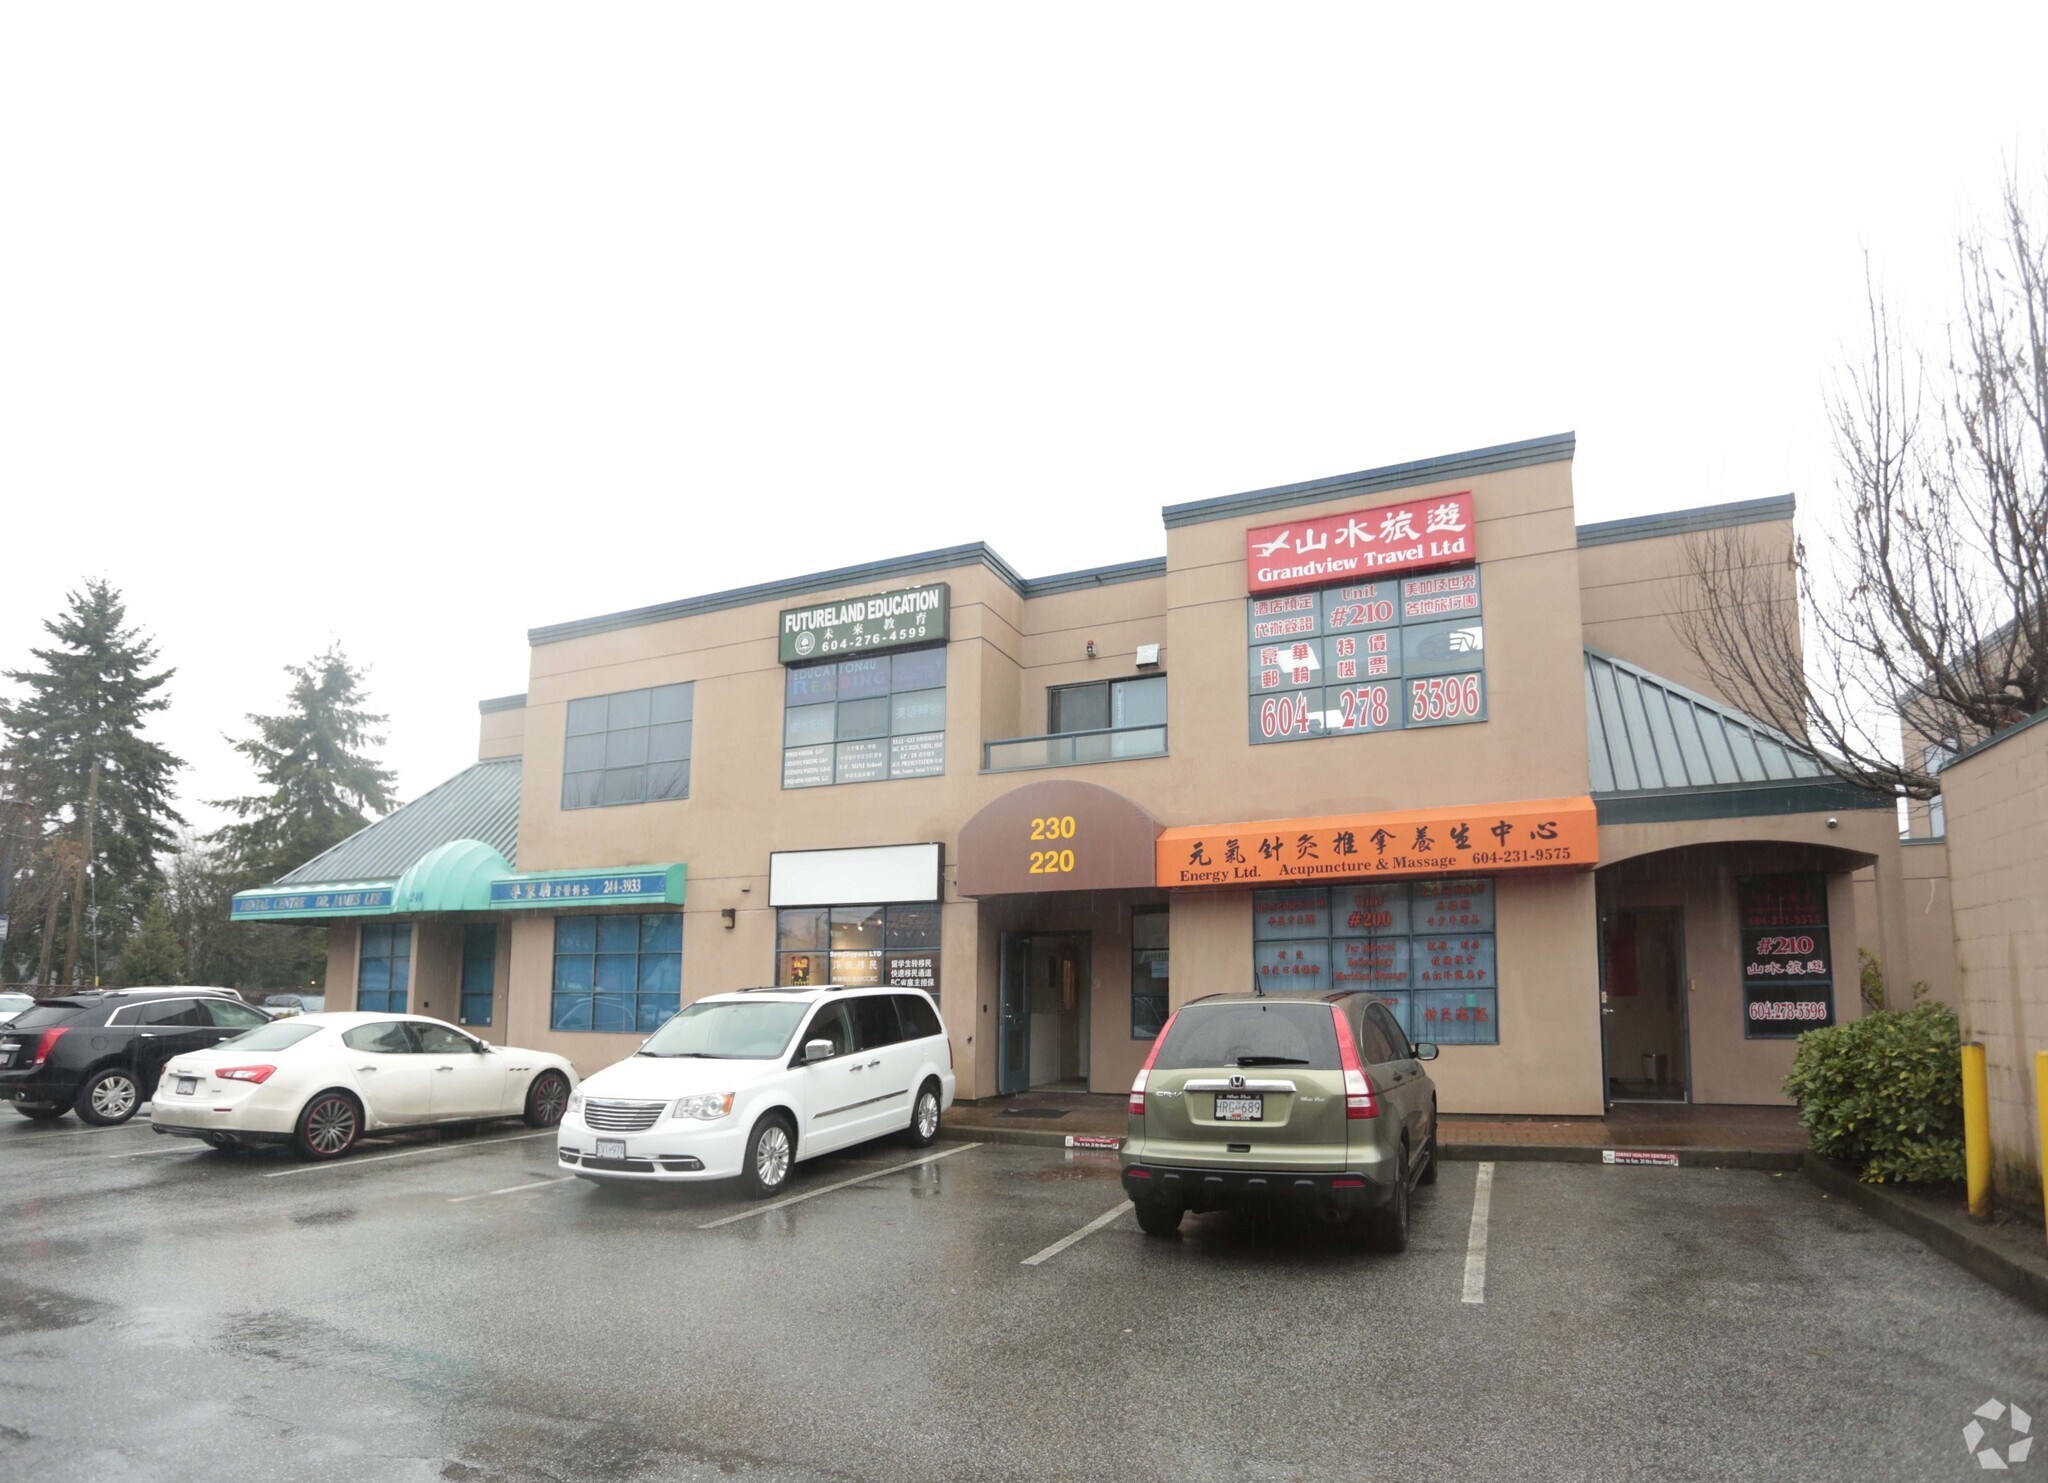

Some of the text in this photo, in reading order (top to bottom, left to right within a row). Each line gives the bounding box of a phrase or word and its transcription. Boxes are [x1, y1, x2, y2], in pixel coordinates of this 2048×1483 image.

[1296, 502, 1466, 554] 山水旅遊
[1258, 538, 1465, 582] Grandview Travel Ltd
[1341, 584, 1377, 600] Unit
[1405, 574, 1475, 597] 美加及世界
[785, 589, 939, 633] FUTURELAND EDUCATION
[1331, 601, 1392, 627] #210
[1406, 594, 1478, 616] 各地旅行團
[823, 611, 927, 640] 未來教育
[822, 626, 926, 652] 604-276-4599
[793, 672, 886, 695] READING
[1261, 674, 1480, 737] 604 278 3396
[1030, 816, 1076, 840] 230
[1029, 850, 1074, 874] 220
[1180, 847, 1571, 882] Energy Ltd. Acupuncture & Massage 604-231-9575
[603, 879, 641, 894] 244-3933
[273, 897, 306, 909] CENTRE
[332, 894, 360, 907] JAMES
[364, 893, 382, 904] LEE
[1348, 911, 1392, 928] #200
[1756, 936, 1814, 954] #210
[1747, 960, 1826, 975] 山水旅遊
[1749, 1000, 1826, 1020] 604-278-3396
